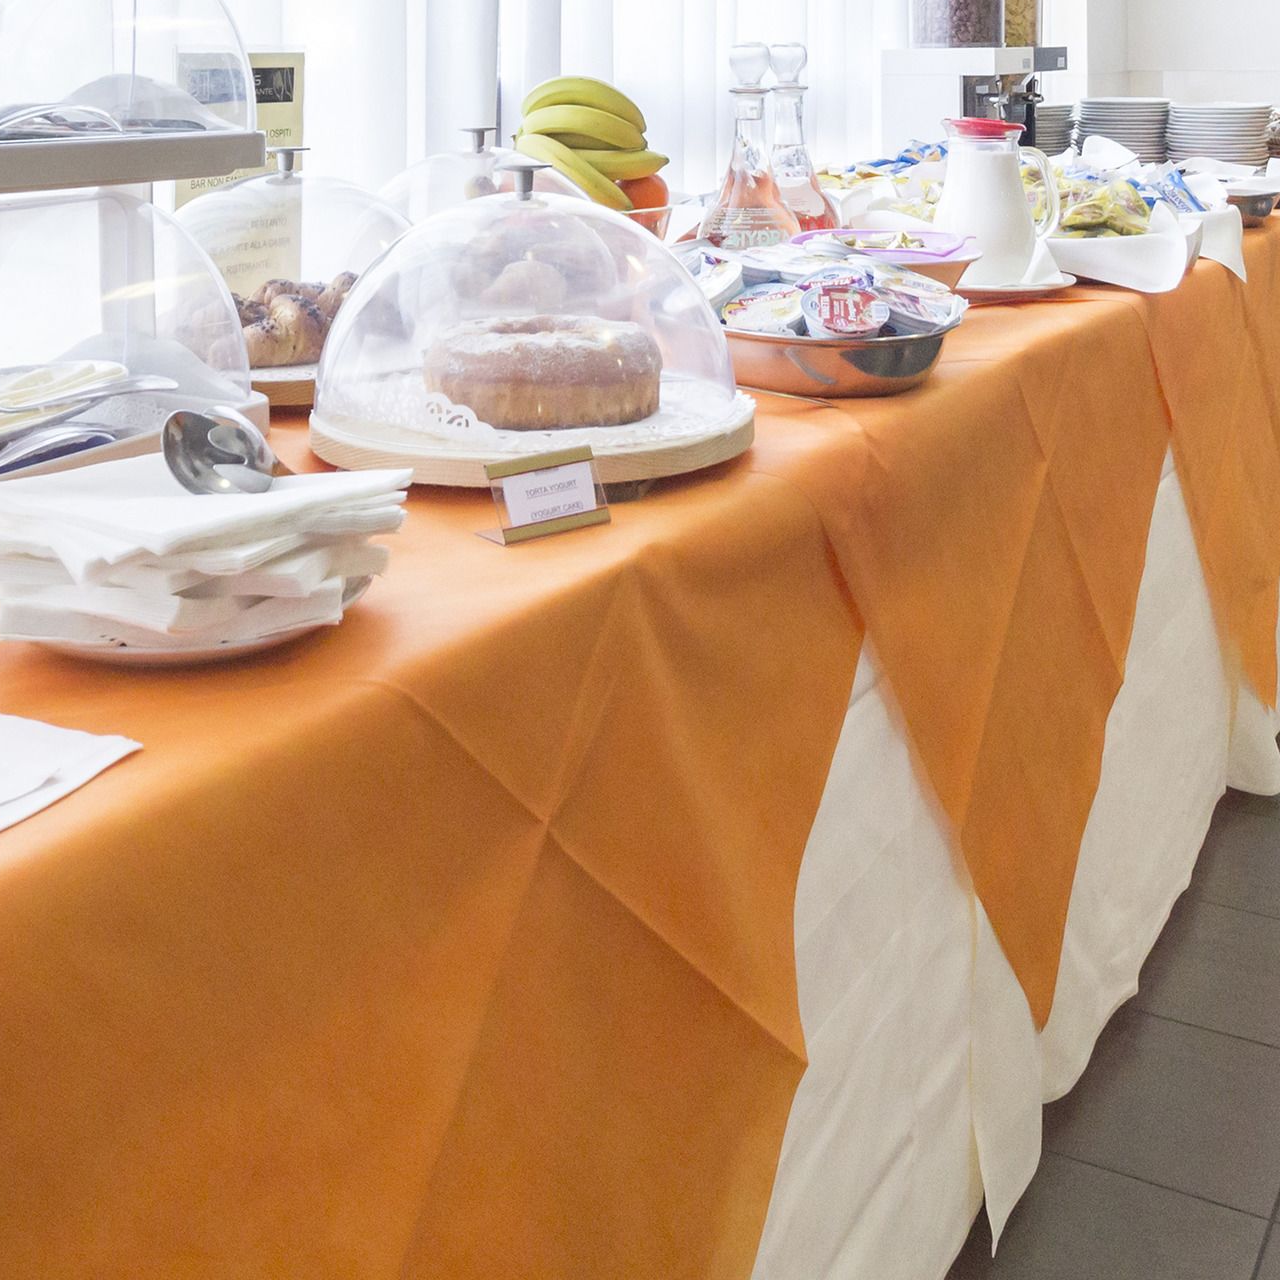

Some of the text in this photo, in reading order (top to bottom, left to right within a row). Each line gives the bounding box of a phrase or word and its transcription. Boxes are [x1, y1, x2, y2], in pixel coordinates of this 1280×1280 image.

[270, 128, 292, 138] OSPITI
[190, 178, 205, 190] BAR
[525, 479, 577, 497] TORTA YOGURT
